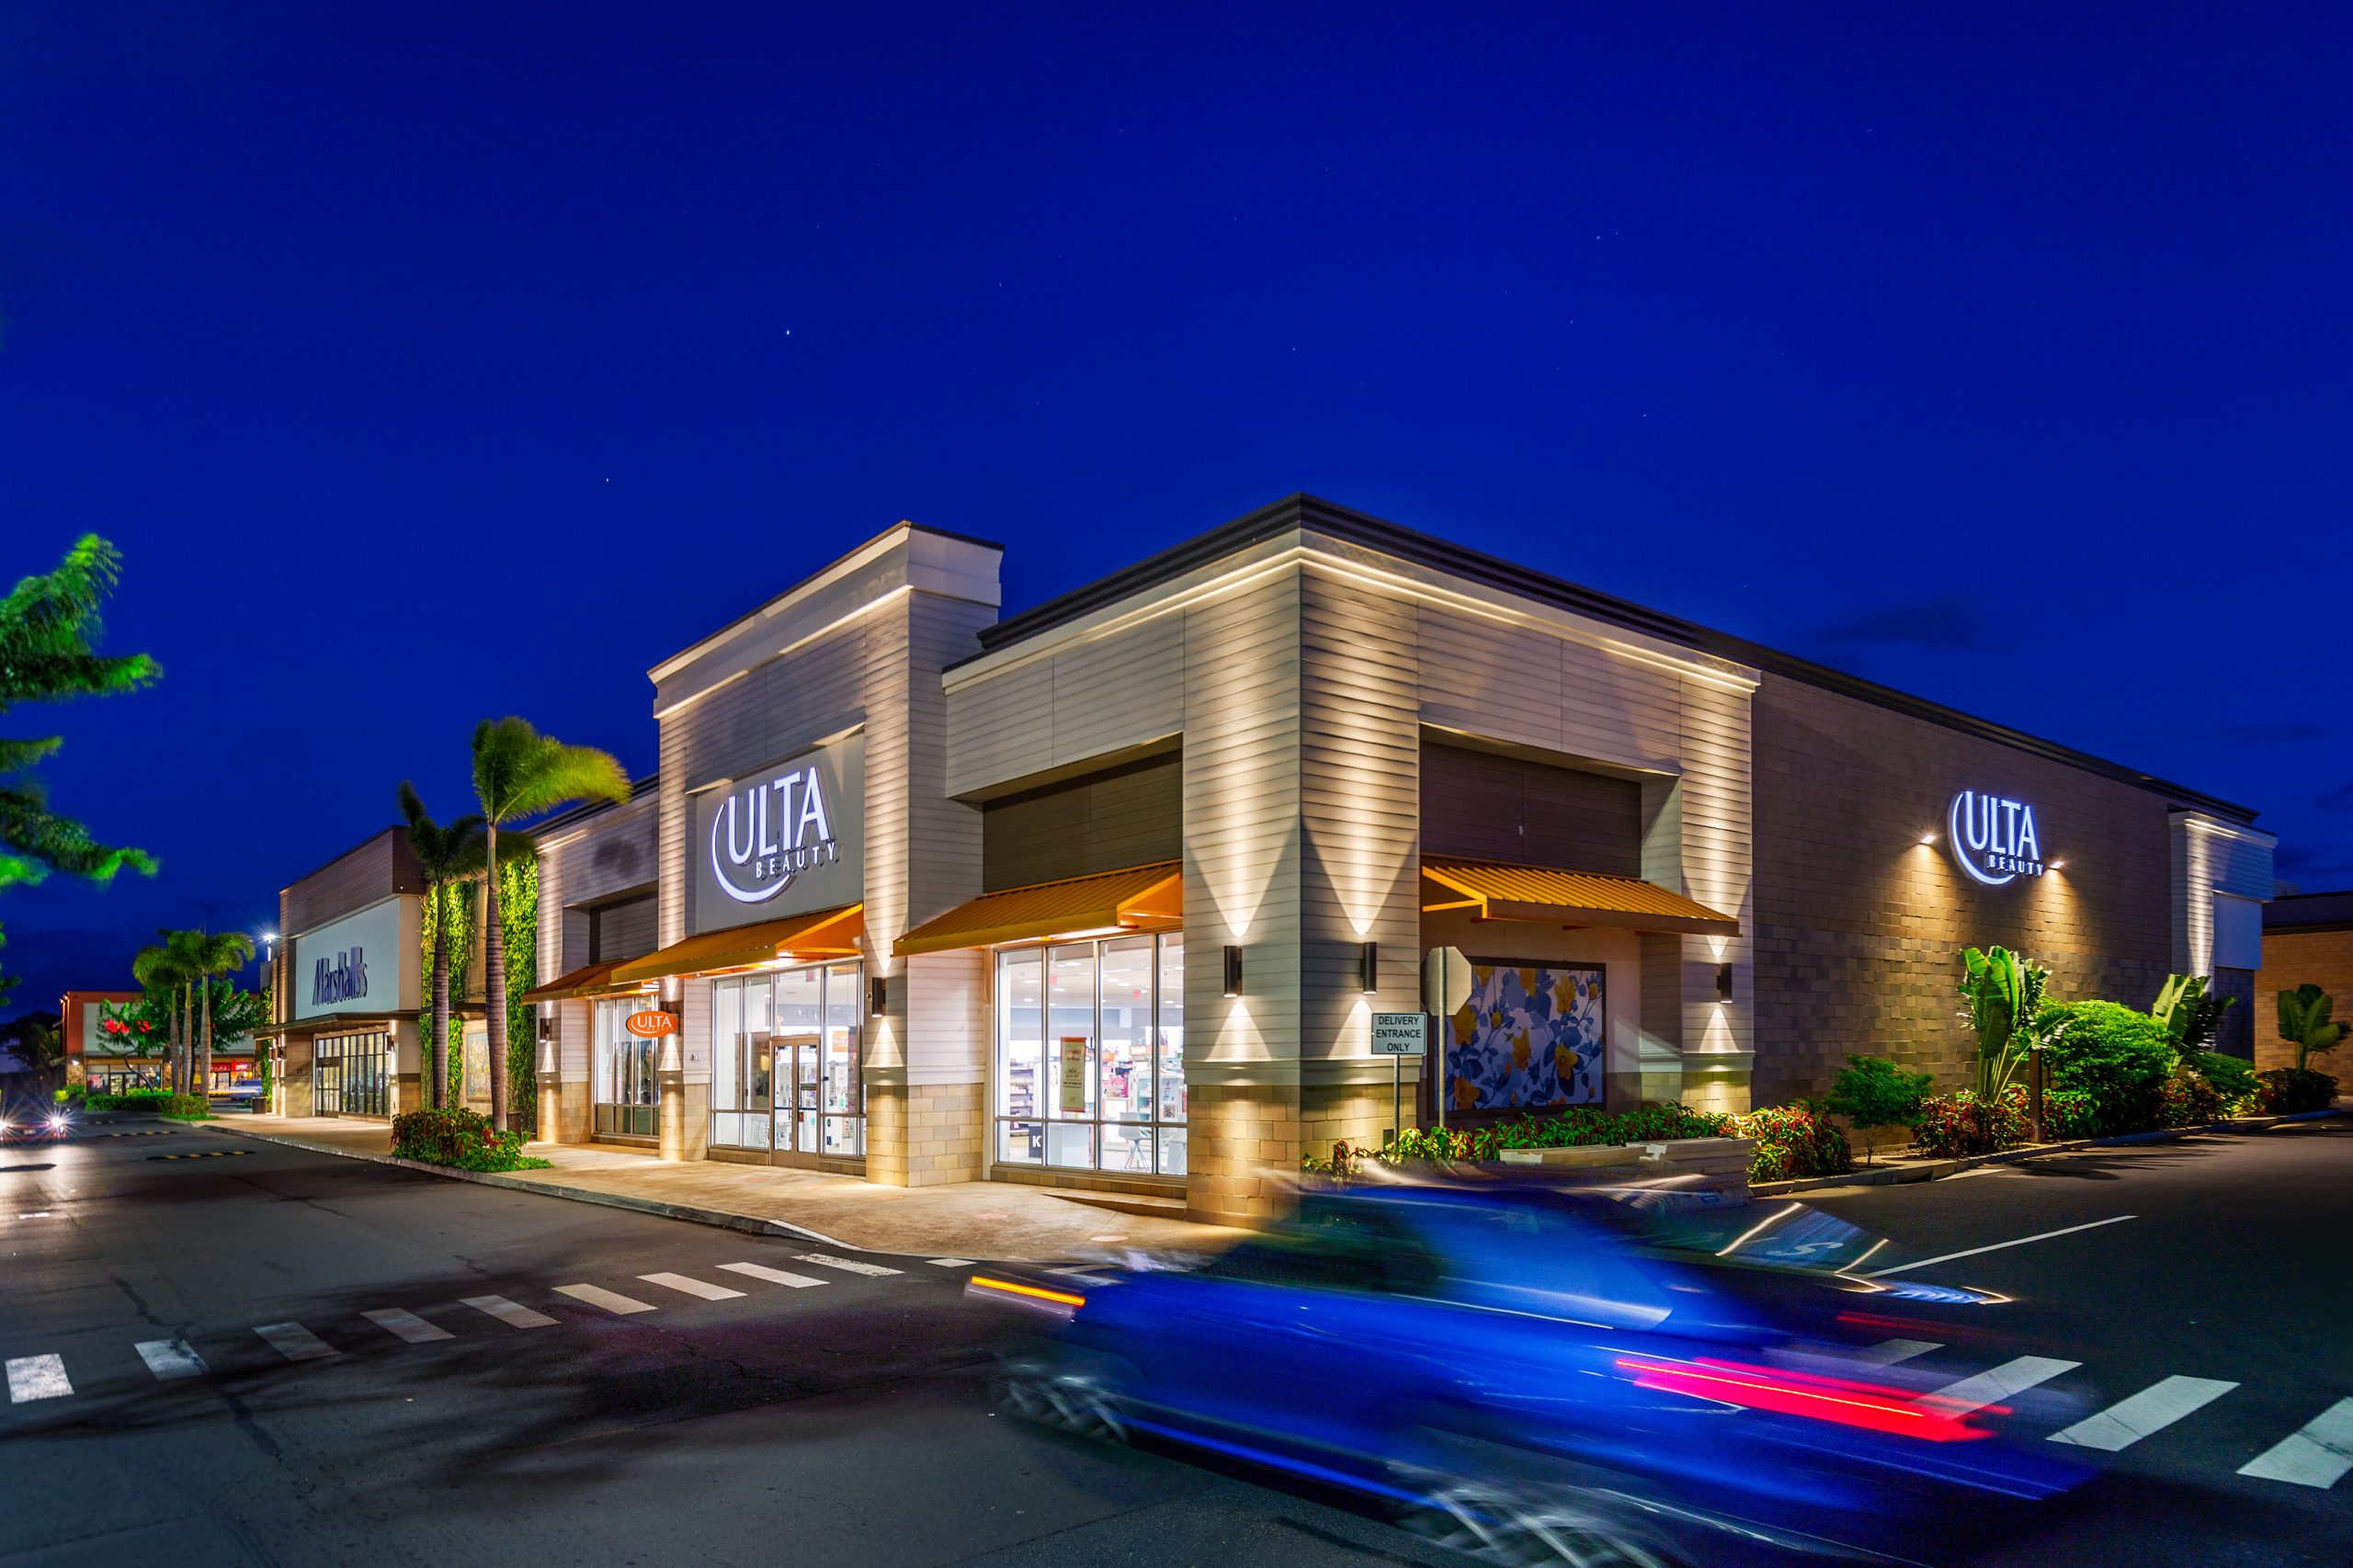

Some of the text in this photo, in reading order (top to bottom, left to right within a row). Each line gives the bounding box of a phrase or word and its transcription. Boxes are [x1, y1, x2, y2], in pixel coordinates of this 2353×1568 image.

[728, 767, 830, 865] ULTA
[1965, 790, 2040, 860] ULTA
[755, 842, 835, 880] BEAUTY
[1988, 855, 2043, 876] BEAUTY
[312, 947, 368, 1006] Marshalls
[637, 1016, 672, 1028] ULTA
[1378, 1016, 1419, 1025] DELIVERY
[1376, 1028, 1421, 1038] ENTRANCE
[1387, 1042, 1410, 1051] ONLY
